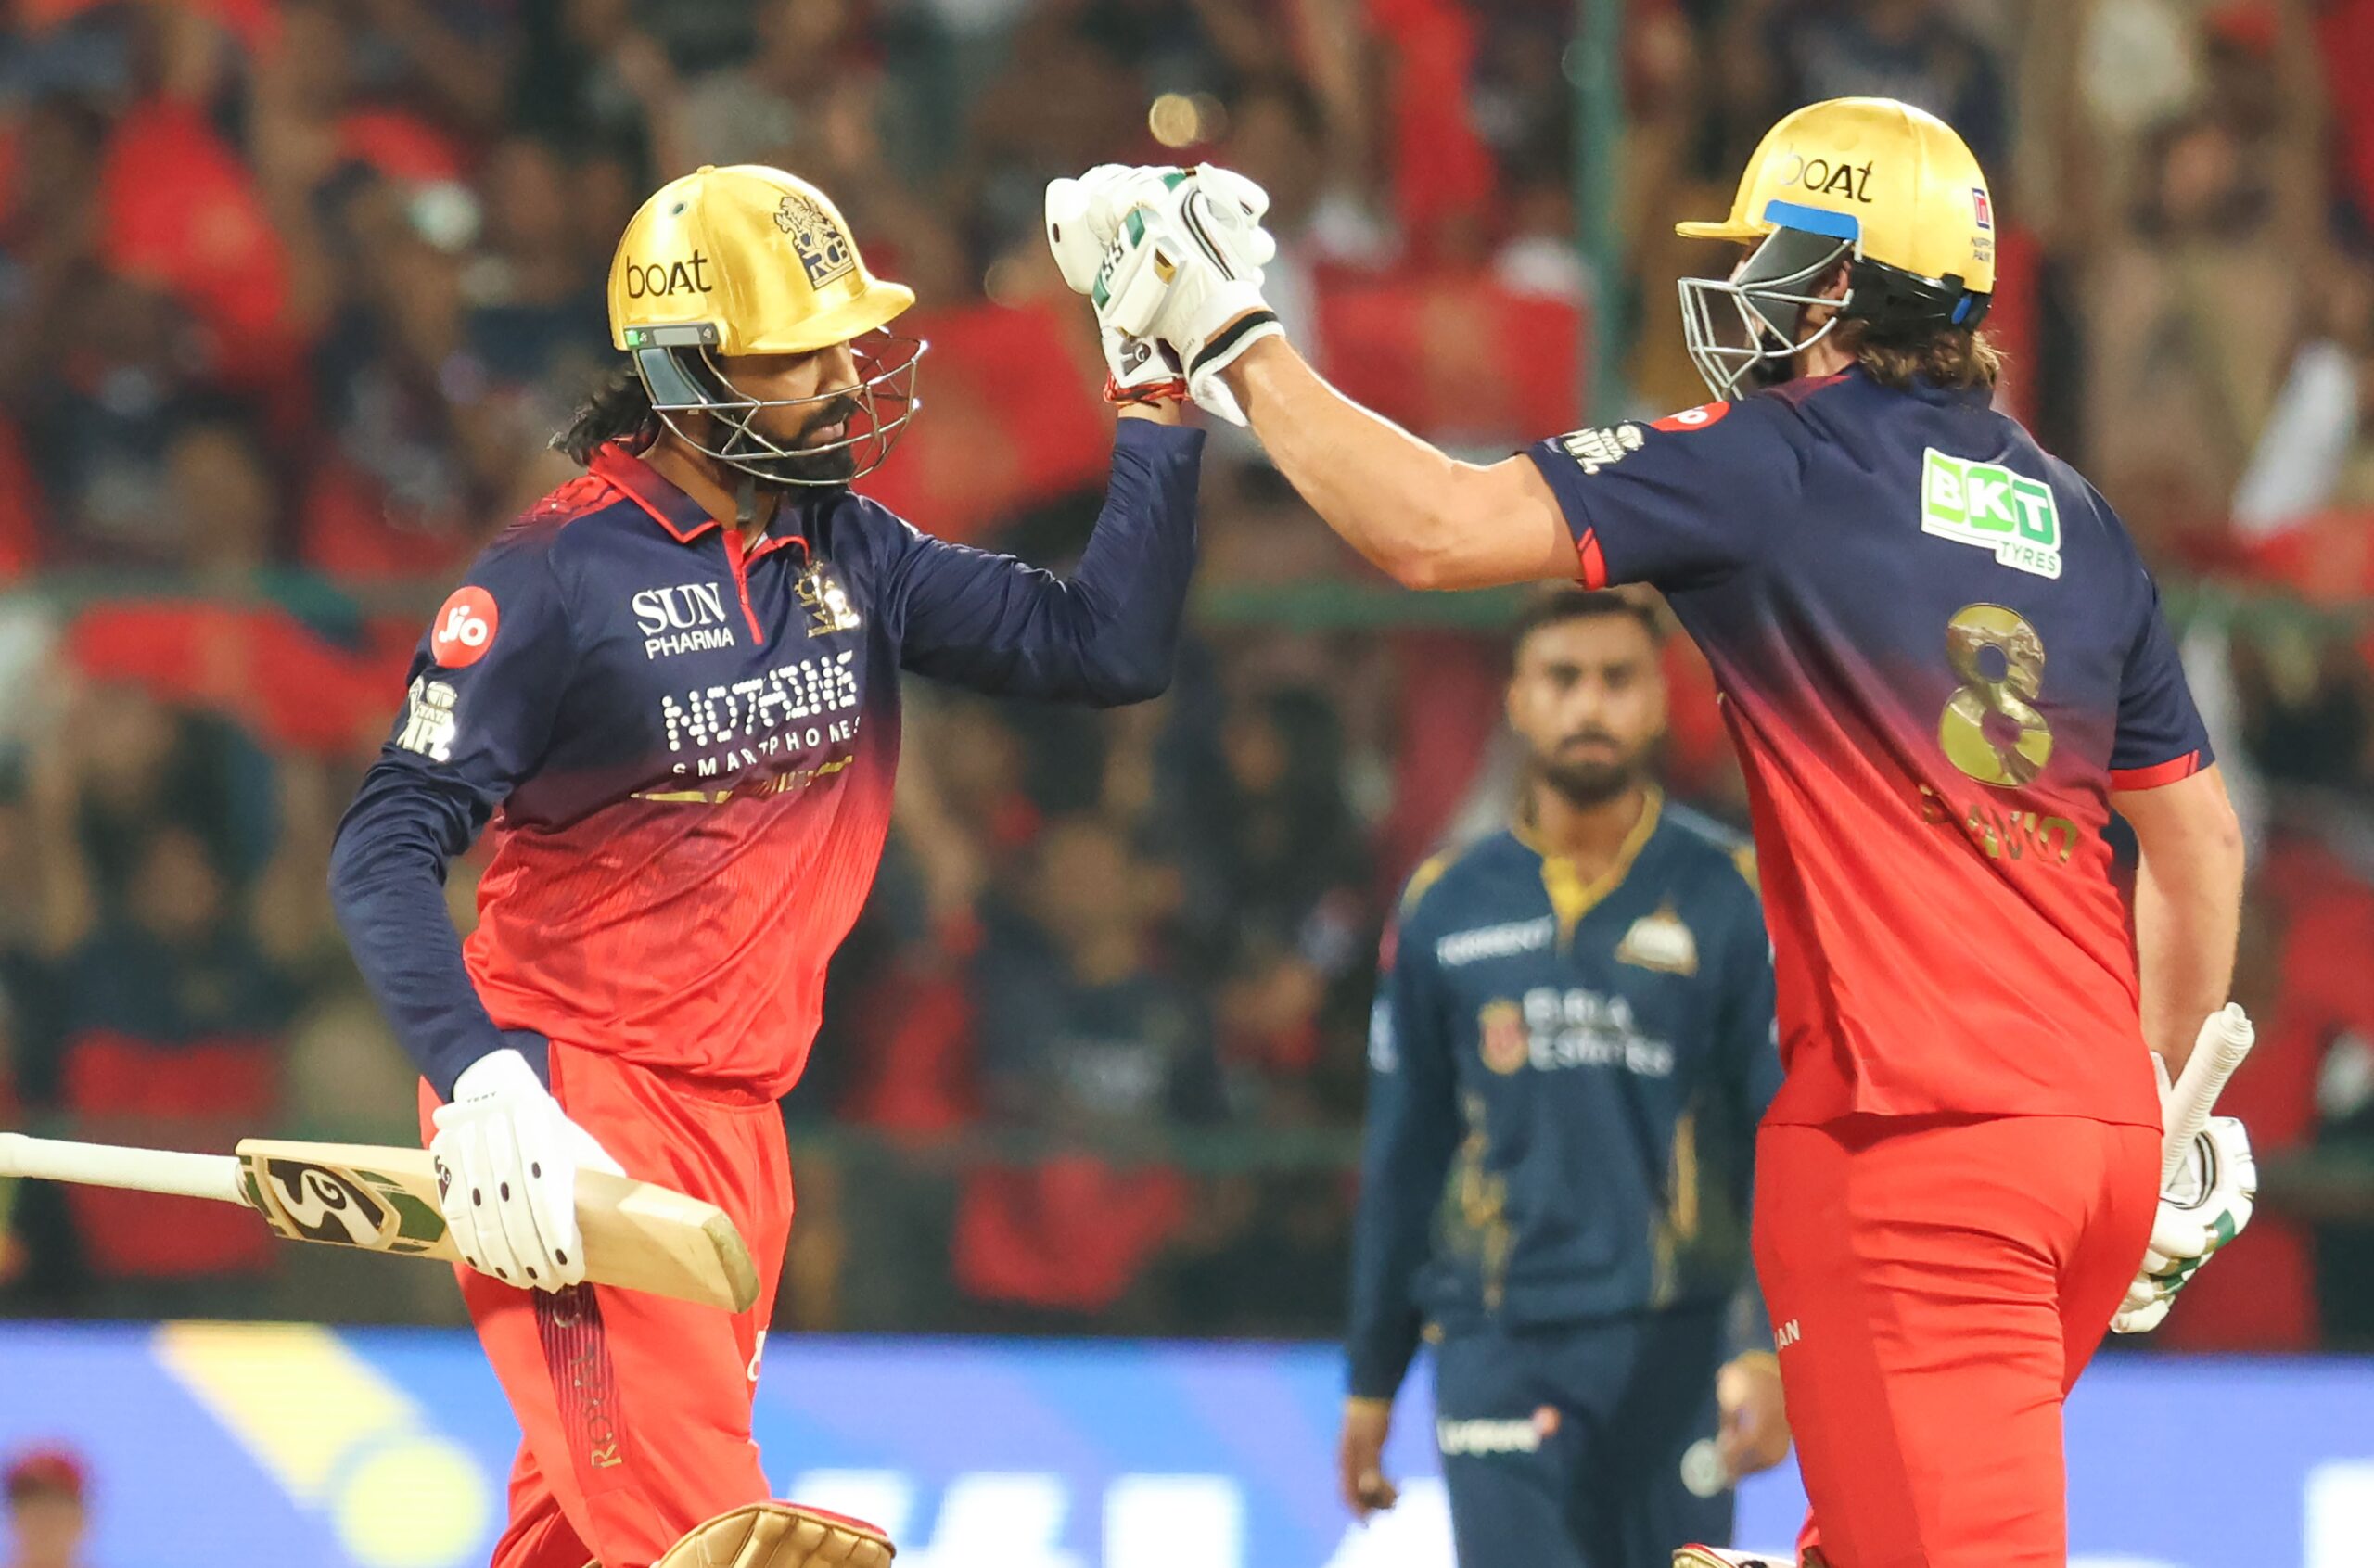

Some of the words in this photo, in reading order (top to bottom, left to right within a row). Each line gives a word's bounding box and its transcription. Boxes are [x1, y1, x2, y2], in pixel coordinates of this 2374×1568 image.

[1929, 463, 2049, 534] BKT
[2000, 541, 2058, 573] TYRES
[632, 582, 727, 636] SUN
[645, 627, 735, 660] PHARMA
[1938, 603, 2054, 787] 8
